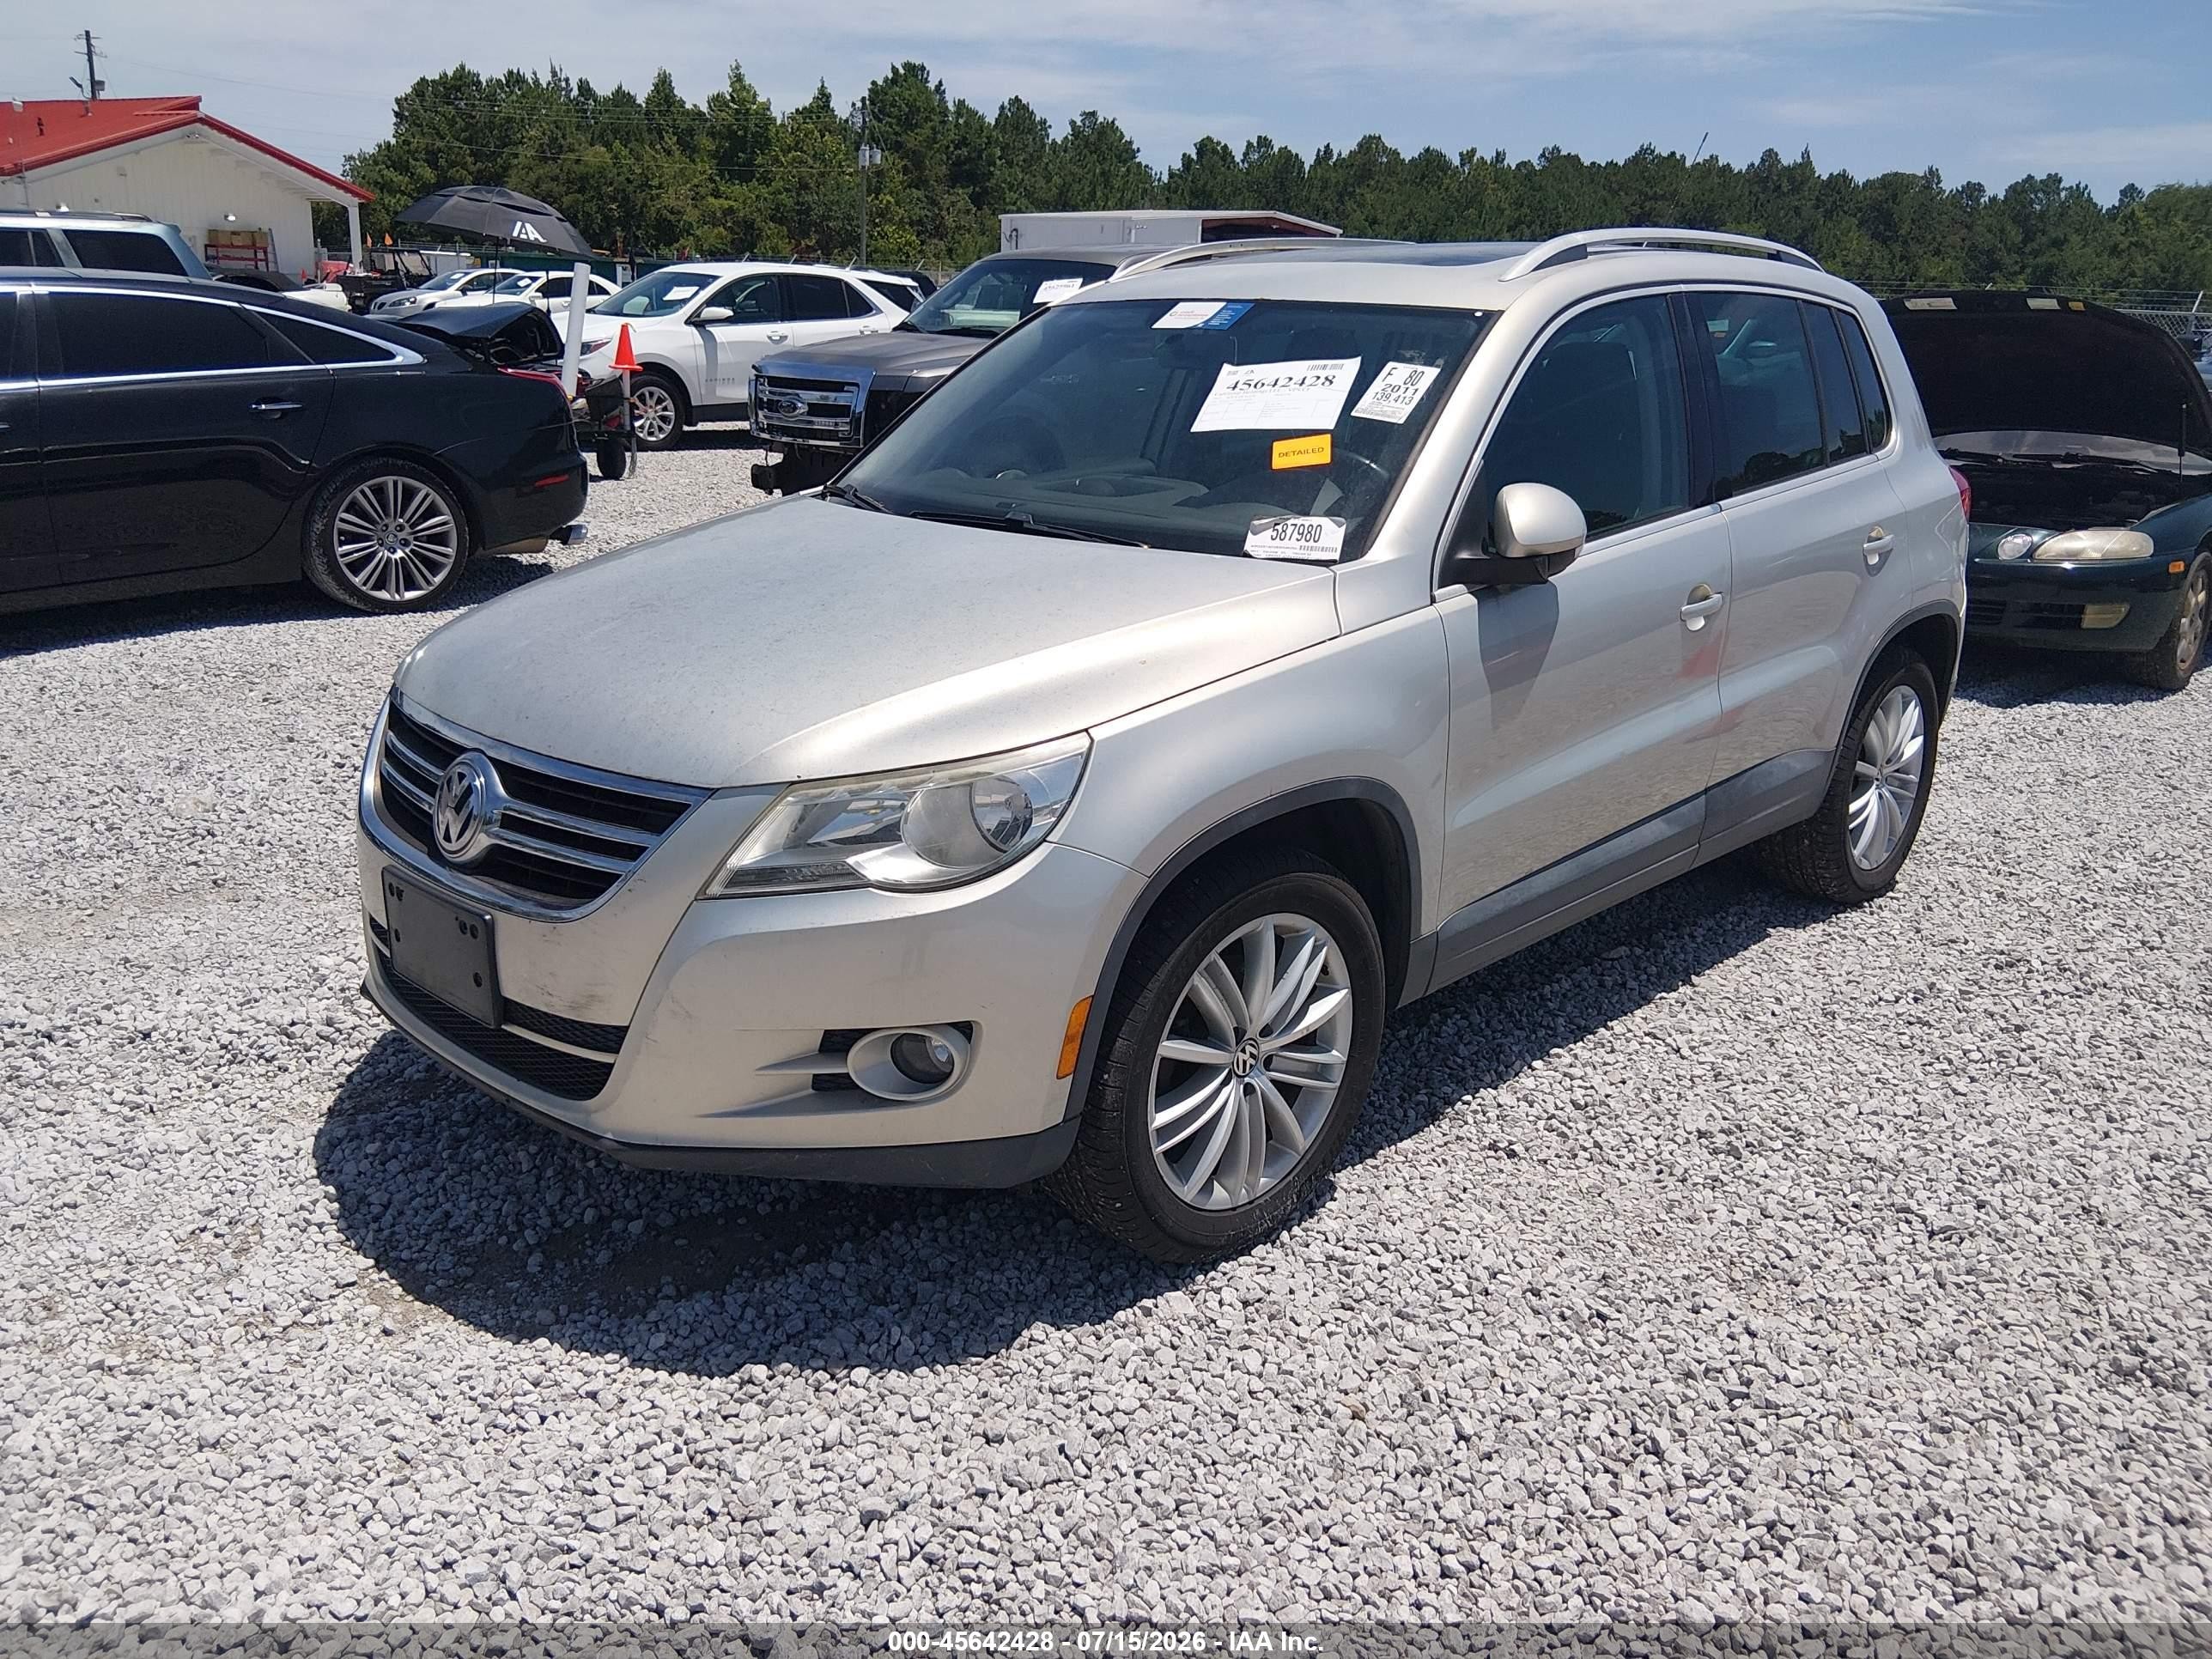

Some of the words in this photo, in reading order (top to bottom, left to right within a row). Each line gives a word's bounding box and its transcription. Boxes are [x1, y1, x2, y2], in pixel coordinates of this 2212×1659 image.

[1226, 374, 1336, 392] 45642428
[1382, 367, 1398, 382] F
[1403, 369, 1425, 386] 80
[1381, 383, 1419, 396] 2011
[1371, 391, 1414, 406] 139,413
[1278, 447, 1325, 459] DETAILED
[1270, 522, 1322, 544] 587980
